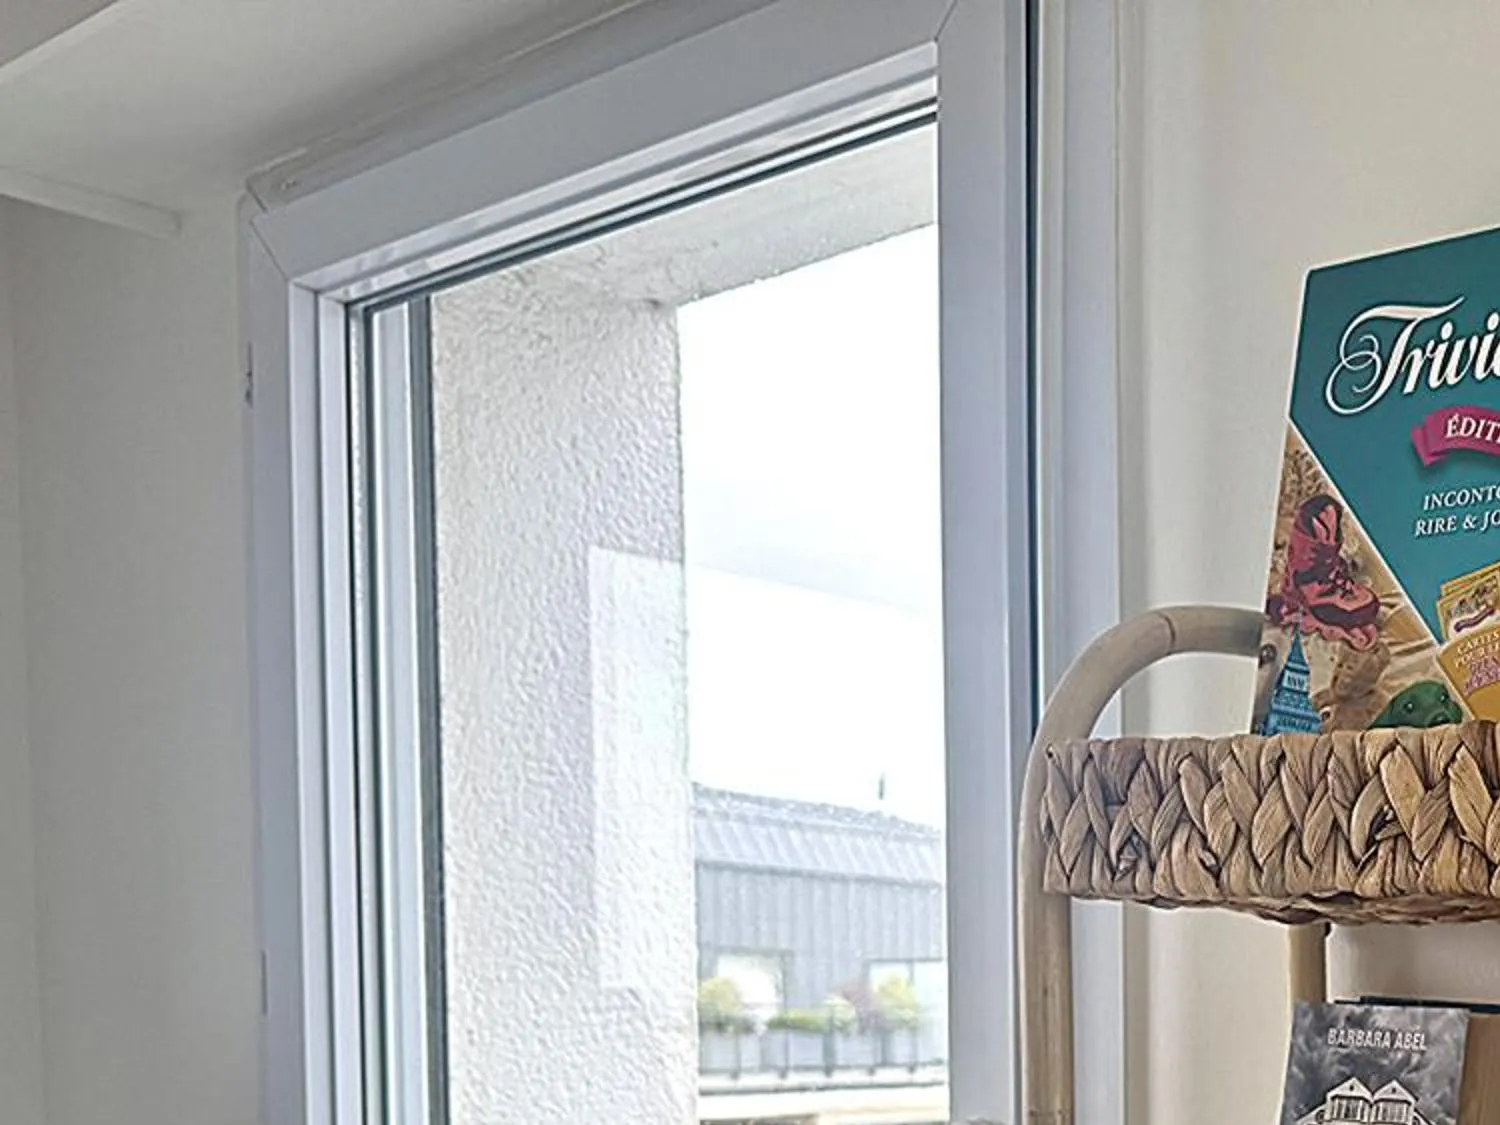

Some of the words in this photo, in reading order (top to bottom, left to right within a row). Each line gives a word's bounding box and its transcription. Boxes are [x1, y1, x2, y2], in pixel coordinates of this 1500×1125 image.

[1415, 515, 1456, 537] RIRE
[1463, 516, 1475, 530] &
[1327, 1027, 1391, 1049] BARBARA
[1394, 1031, 1427, 1051] ABEL
